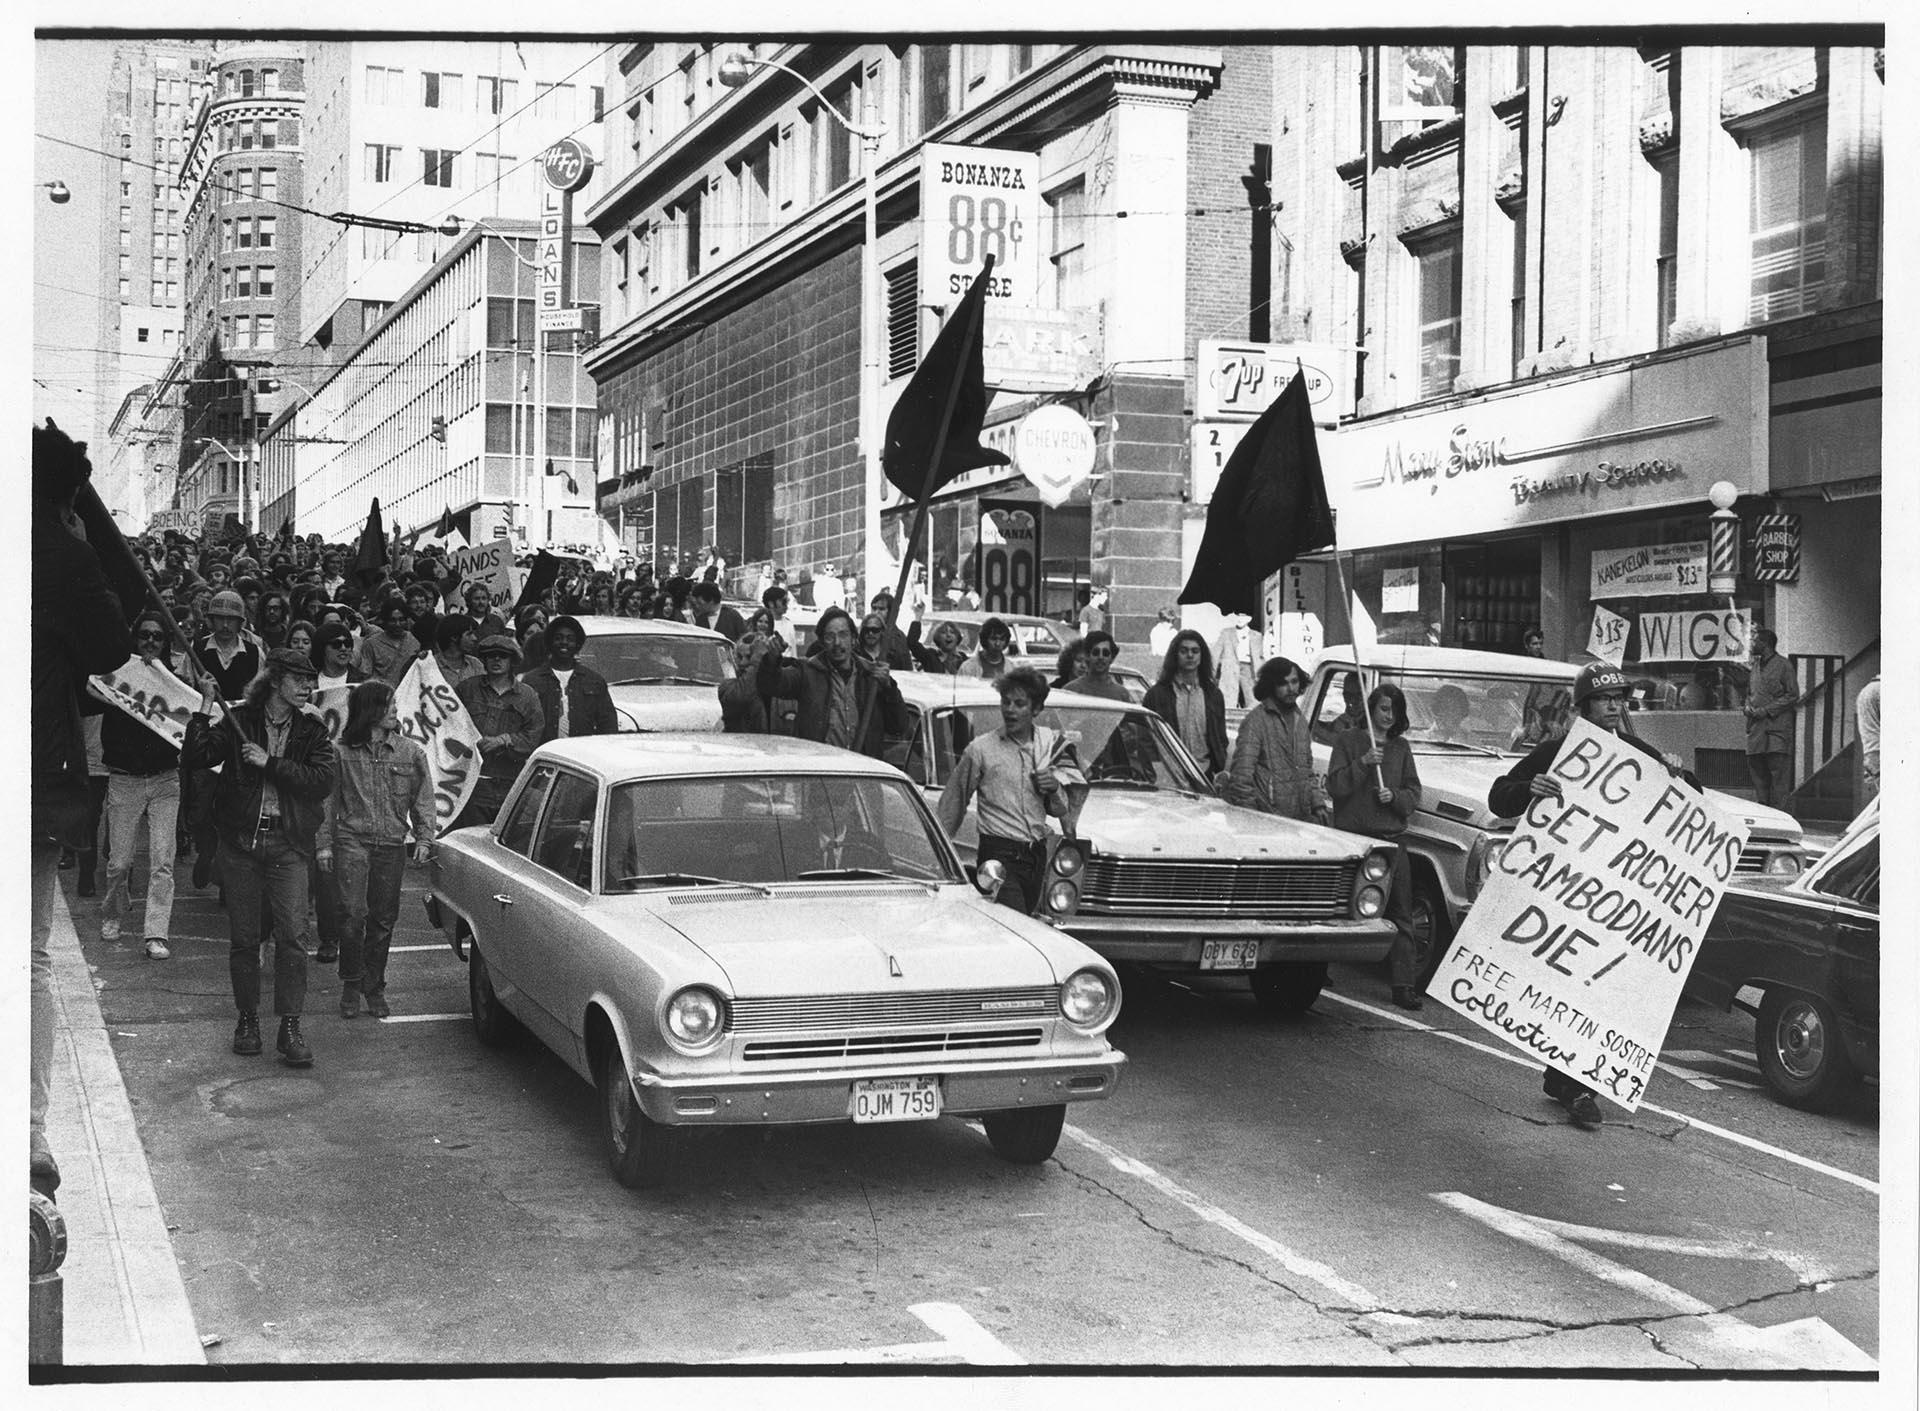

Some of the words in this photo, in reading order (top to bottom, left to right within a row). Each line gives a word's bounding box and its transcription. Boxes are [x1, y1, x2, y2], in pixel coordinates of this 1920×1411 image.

[546, 147, 580, 180] HFC
[941, 161, 1026, 190] BONANZA
[543, 192, 558, 307] LOANS
[950, 273, 1013, 298] STRE
[1273, 375, 1294, 388] FRE
[1308, 378, 1322, 391] UP
[1026, 428, 1088, 450] CHEVRON
[1596, 457, 1678, 485] SCHOOL
[152, 510, 198, 528] BOEING
[1762, 531, 1795, 548] BARBER
[1597, 548, 1649, 587] KANEKELON
[1765, 550, 1789, 564] SHOP
[1642, 612, 1745, 661] WIGS
[1553, 737, 1642, 804] BIG
[1643, 784, 1742, 882] FIRMS
[1526, 794, 1619, 853] GET
[1608, 838, 1714, 927] RICHER
[1499, 834, 1693, 973] CAMBODIANS
[1450, 978, 1577, 1068] Collective
[1451, 945, 1515, 991] FREE
[1519, 984, 1600, 1040] MARTIN
[1601, 1030, 1656, 1075] SOSTRE
[858, 1081, 911, 1092] WASHINGTON
[858, 1093, 893, 1116] OJM
[900, 1090, 935, 1114] 759
